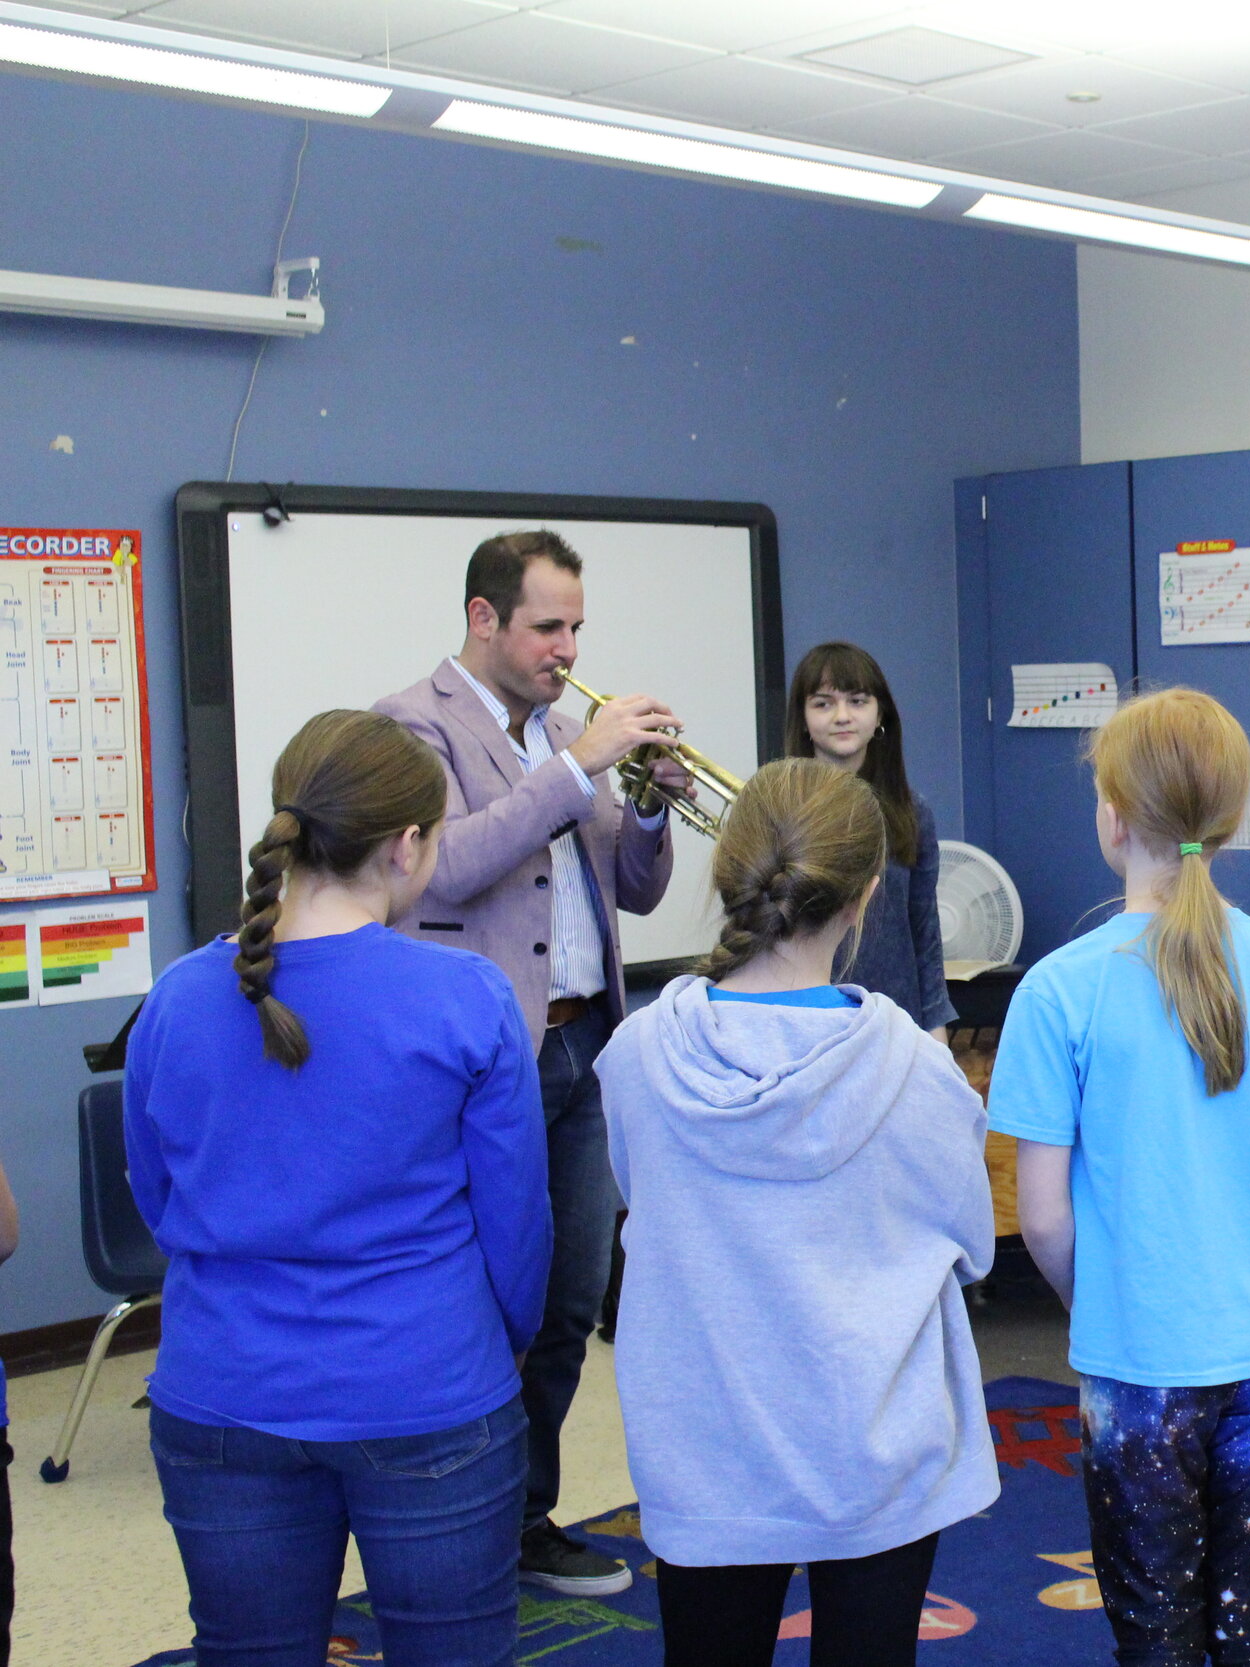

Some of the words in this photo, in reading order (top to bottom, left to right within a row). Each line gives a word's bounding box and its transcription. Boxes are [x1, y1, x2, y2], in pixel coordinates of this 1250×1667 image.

[6, 651, 26, 660] Head
[7, 661, 27, 669] Joint
[10, 748, 31, 759] Body
[11, 759, 32, 768] Joint
[15, 835, 34, 843] Foot
[15, 844, 35, 853] Joint
